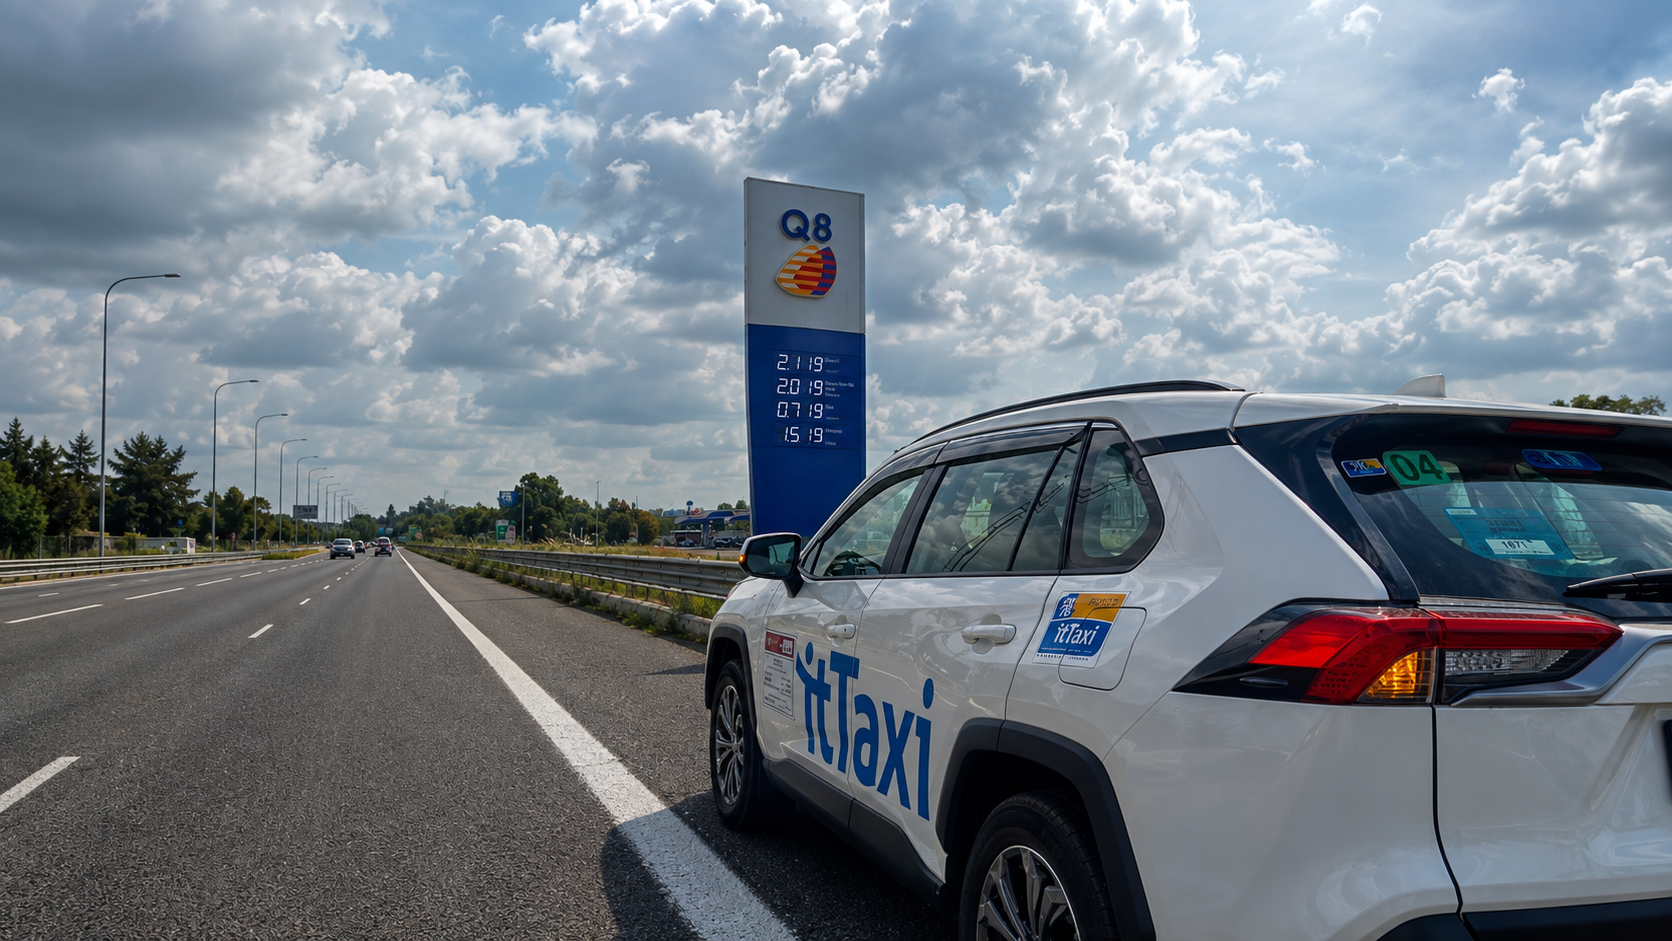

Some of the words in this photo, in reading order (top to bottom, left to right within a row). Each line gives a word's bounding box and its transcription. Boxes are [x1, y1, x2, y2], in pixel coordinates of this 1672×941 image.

[780, 208, 833, 243] Q8
[776, 378, 824, 396] 2.019
[776, 402, 824, 419] 0.719
[1389, 453, 1444, 482] 04
[1053, 622, 1100, 646] itTaxi
[796, 641, 934, 821] itTaxi
